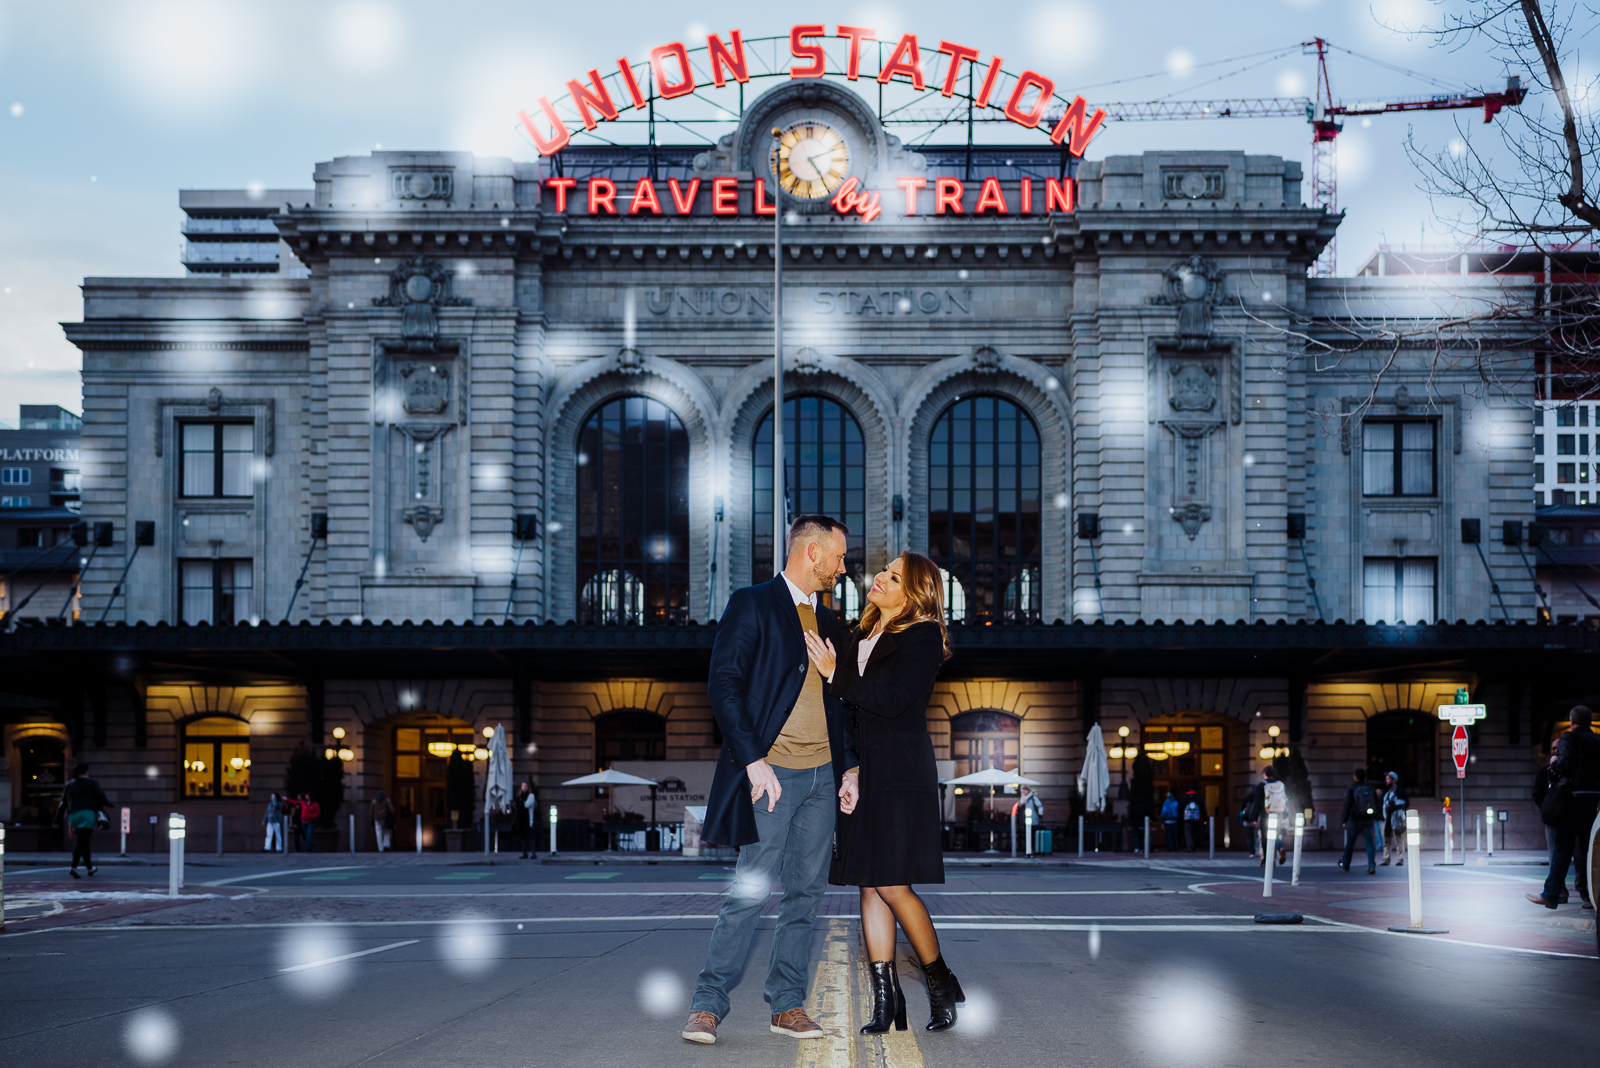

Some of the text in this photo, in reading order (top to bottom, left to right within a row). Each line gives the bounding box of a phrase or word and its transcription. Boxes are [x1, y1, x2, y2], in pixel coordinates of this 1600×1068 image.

[517, 24, 1107, 158] UNION STATION
[545, 175, 1076, 224] TRAVEL by TRAIN
[645, 291, 971, 316] UNION STATION
[1454, 738, 1468, 755] STOP
